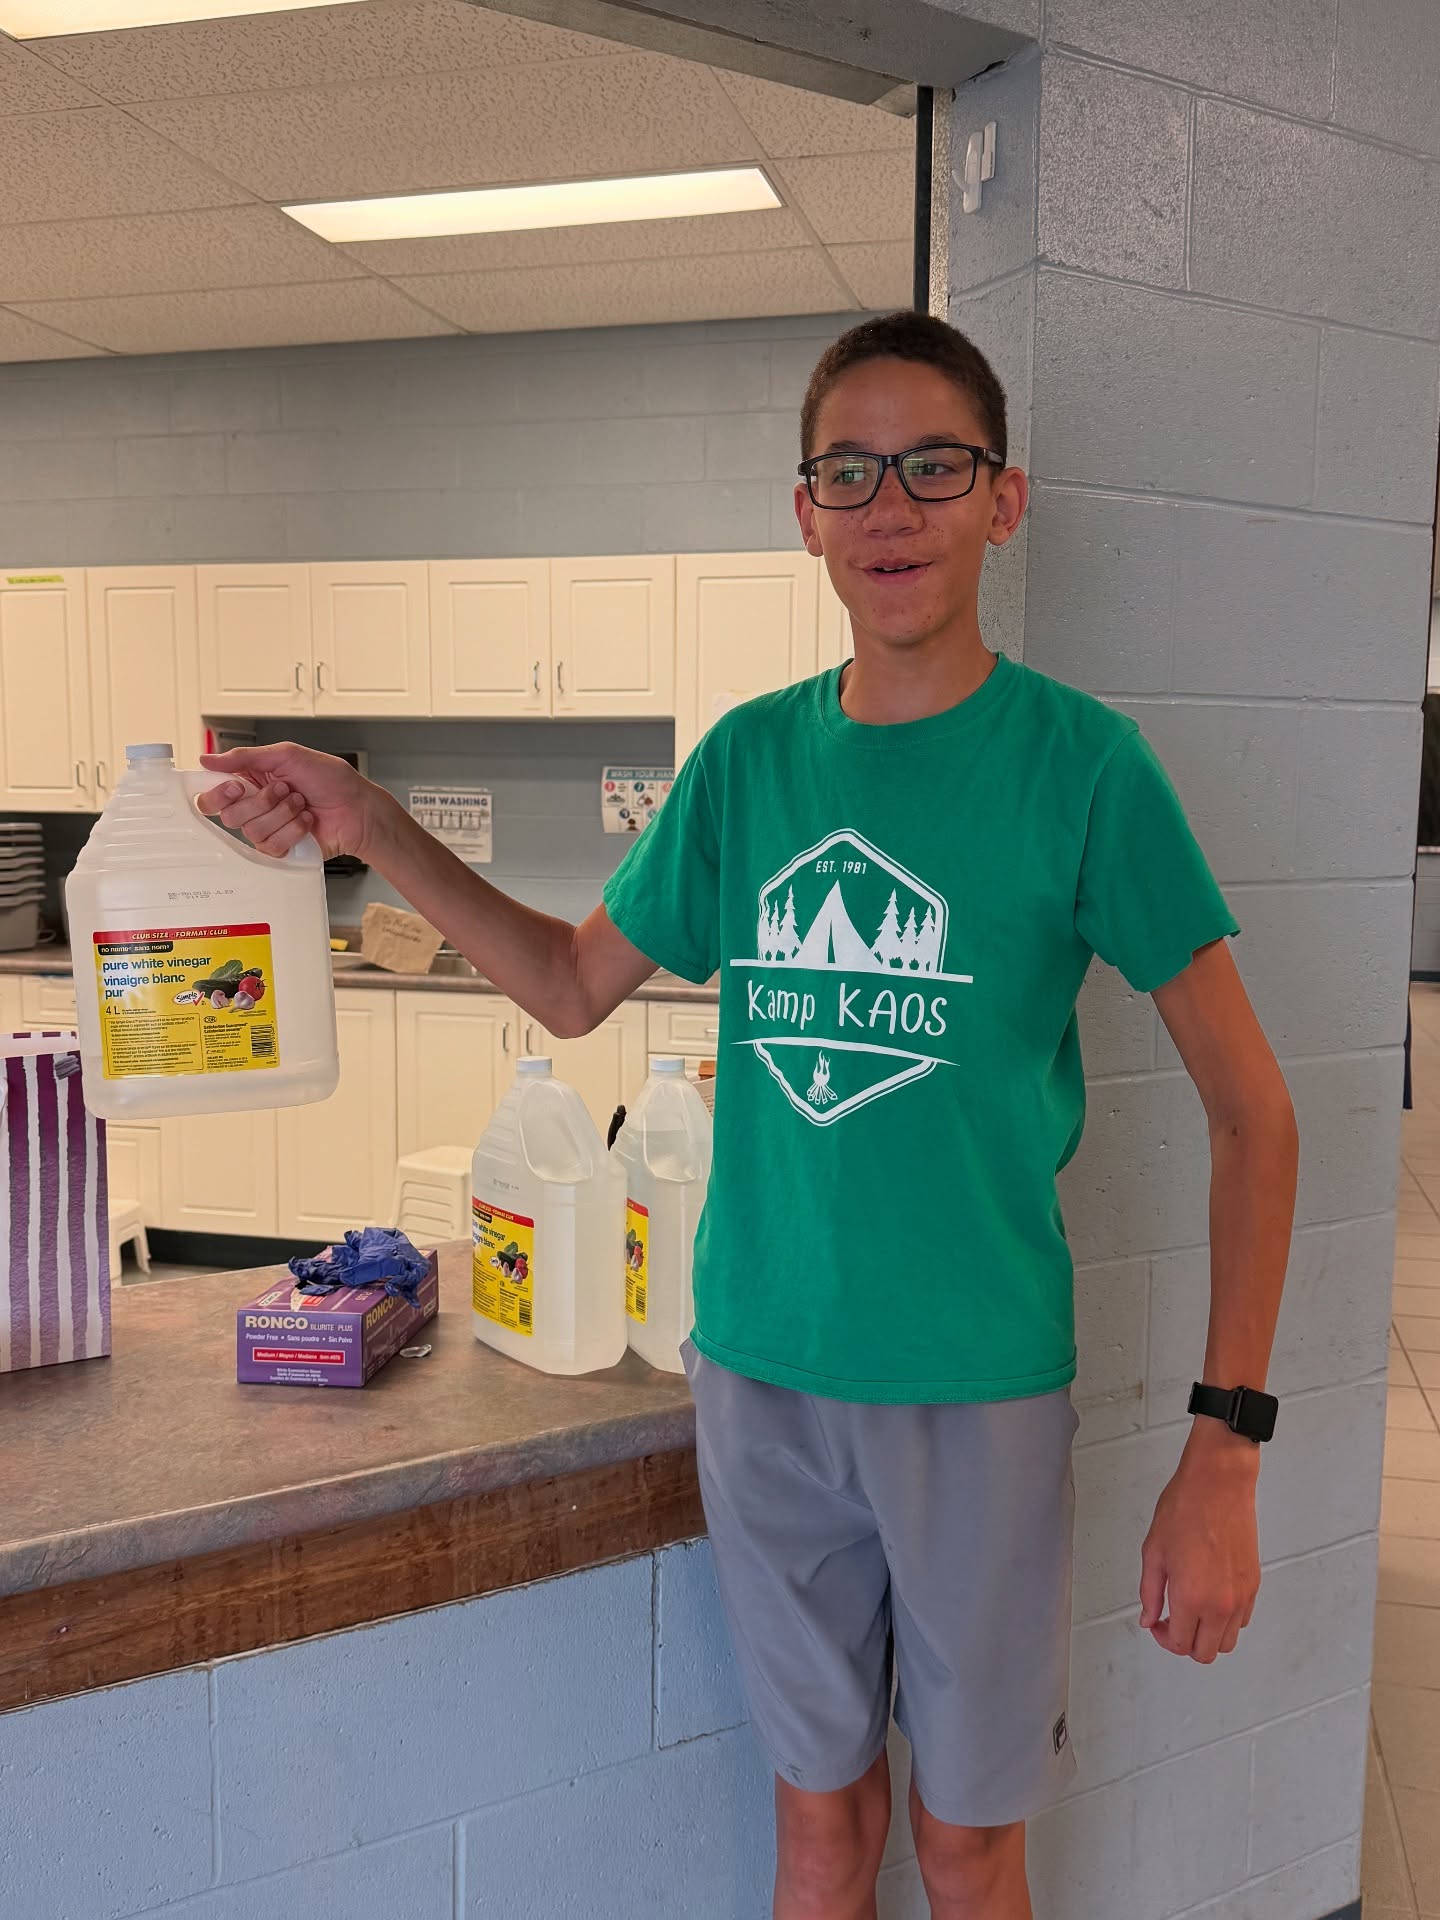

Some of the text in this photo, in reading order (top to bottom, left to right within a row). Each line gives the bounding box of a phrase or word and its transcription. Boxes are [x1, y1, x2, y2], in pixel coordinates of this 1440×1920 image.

[412, 796, 488, 806] DISH WASHING
[815, 860, 867, 874] EST. 1981
[175, 930, 208, 938] FORMAT
[102, 956, 212, 972] pure white vinegar
[103, 973, 186, 987] vinaigre blanc
[105, 988, 125, 1000] pur
[176, 991, 198, 1002] Simple
[105, 1006, 112, 1015] 4
[114, 1005, 121, 1015] L
[747, 979, 948, 1037] Kamp KAOS
[366, 1296, 394, 1330] RONCO
[245, 1315, 353, 1332] RONCO BLURITE PLUS
[301, 1335, 320, 1343] poudre
